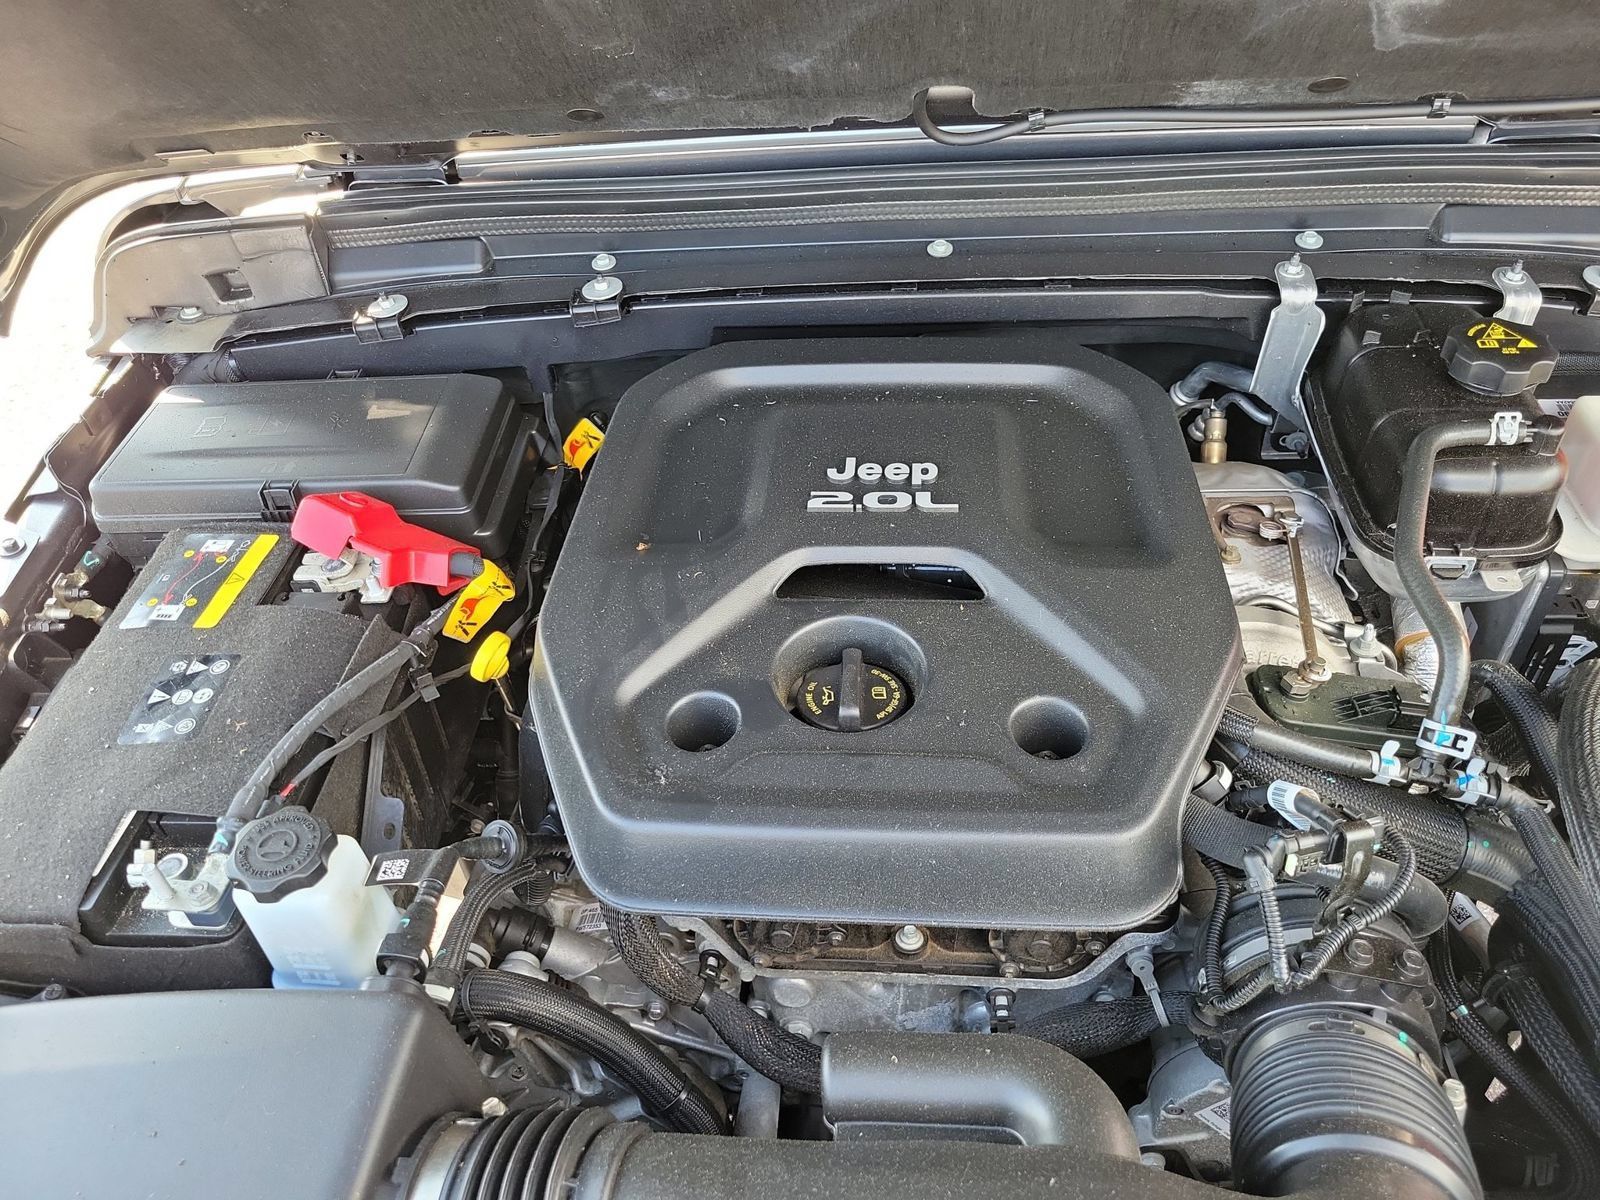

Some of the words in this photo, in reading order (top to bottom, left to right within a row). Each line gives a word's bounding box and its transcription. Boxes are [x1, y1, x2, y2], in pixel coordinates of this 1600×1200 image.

[827, 457, 939, 489] Jeep
[806, 491, 959, 513] 2.0L
[807, 681, 818, 692] OIL
[805, 693, 822, 715] ENGINE
[273, 815, 314, 831] APPROVED
